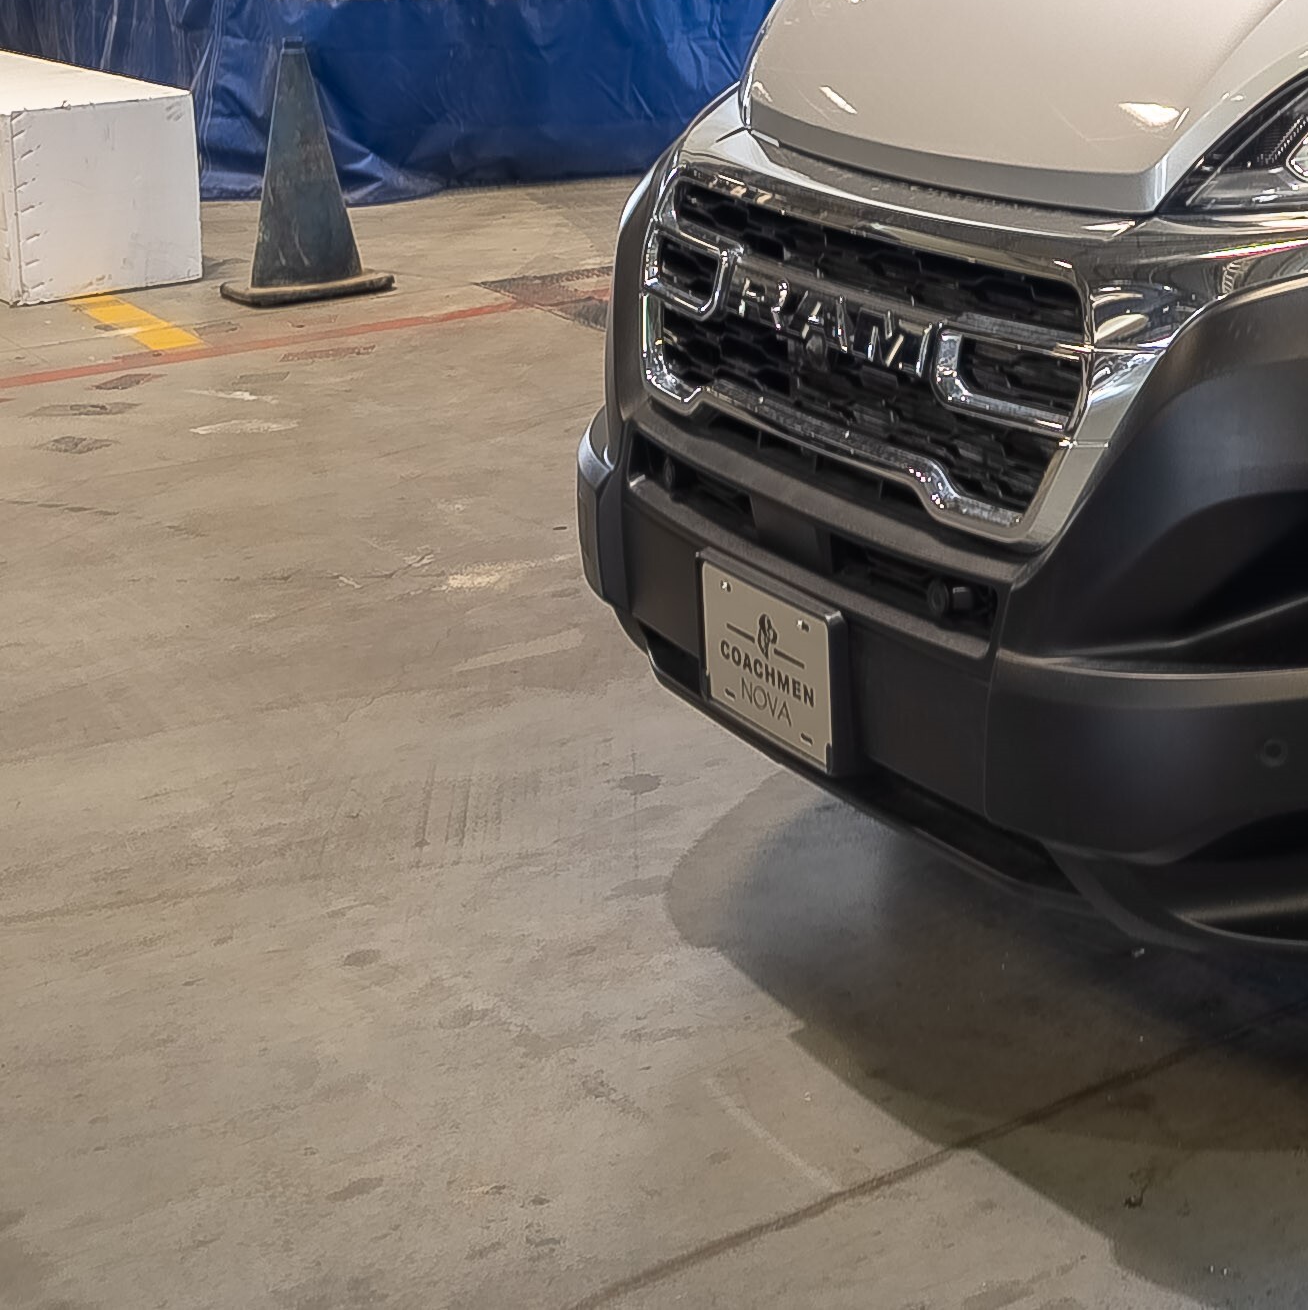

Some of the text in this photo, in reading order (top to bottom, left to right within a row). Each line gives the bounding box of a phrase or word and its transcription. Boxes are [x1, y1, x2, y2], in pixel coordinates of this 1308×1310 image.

[737, 274, 937, 378] RAM
[720, 640, 814, 708] COACHMEN
[741, 677, 791, 727] NOVA
